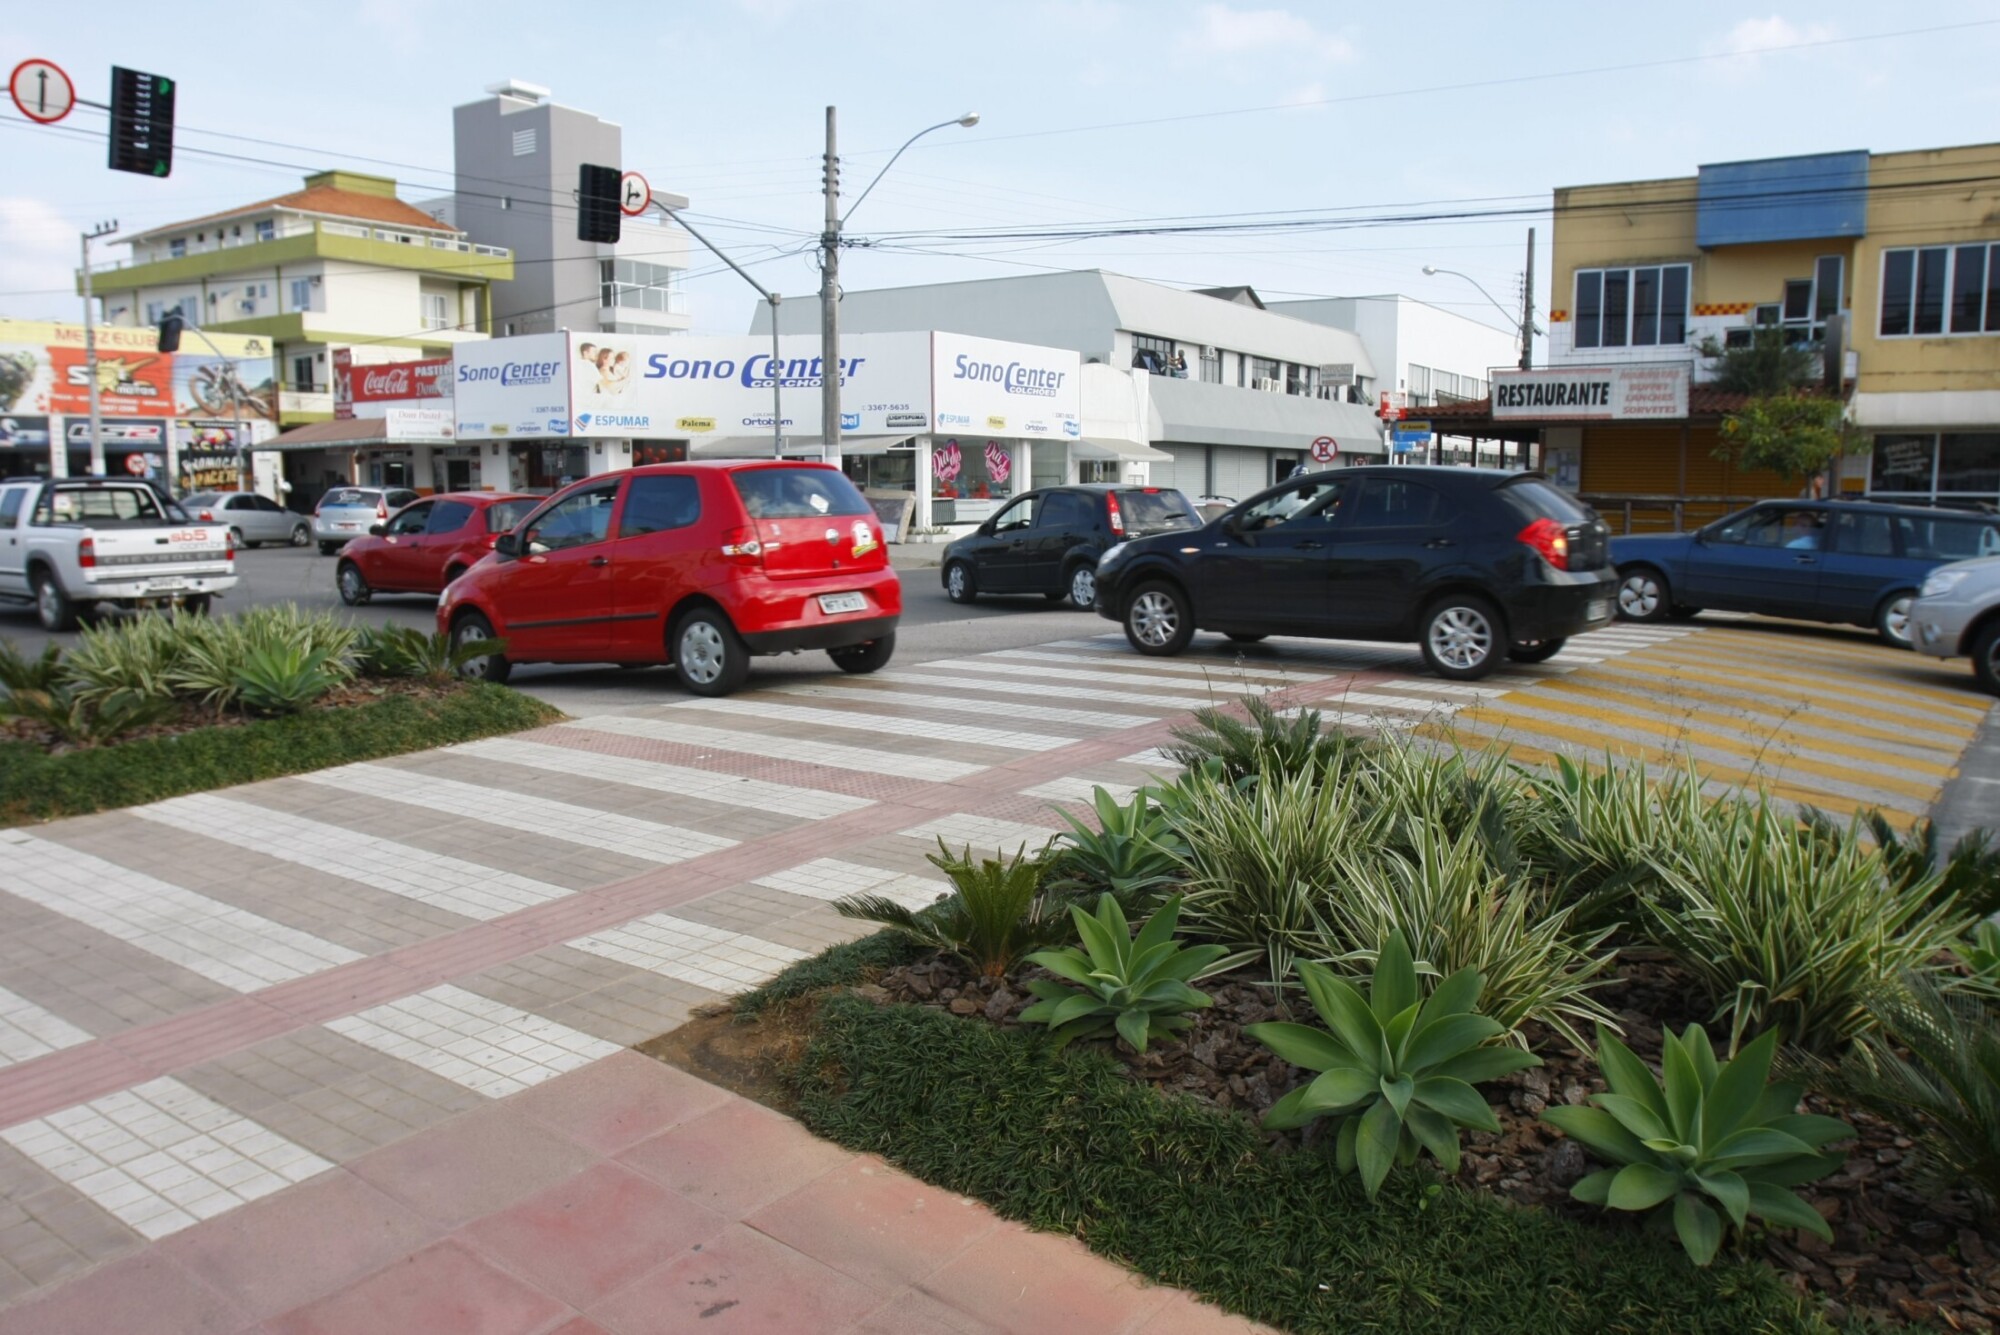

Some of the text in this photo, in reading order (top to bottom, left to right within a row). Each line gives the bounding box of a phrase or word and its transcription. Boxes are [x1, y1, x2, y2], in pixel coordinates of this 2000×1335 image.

[1497, 382, 1610, 408] RESTAURANTE
[1623, 405, 1677, 414] SORVETES
[595, 415, 650, 427] ESPUMAR
[742, 418, 793, 426] Ortobm
[103, 552, 219, 564] CHEVROLET
